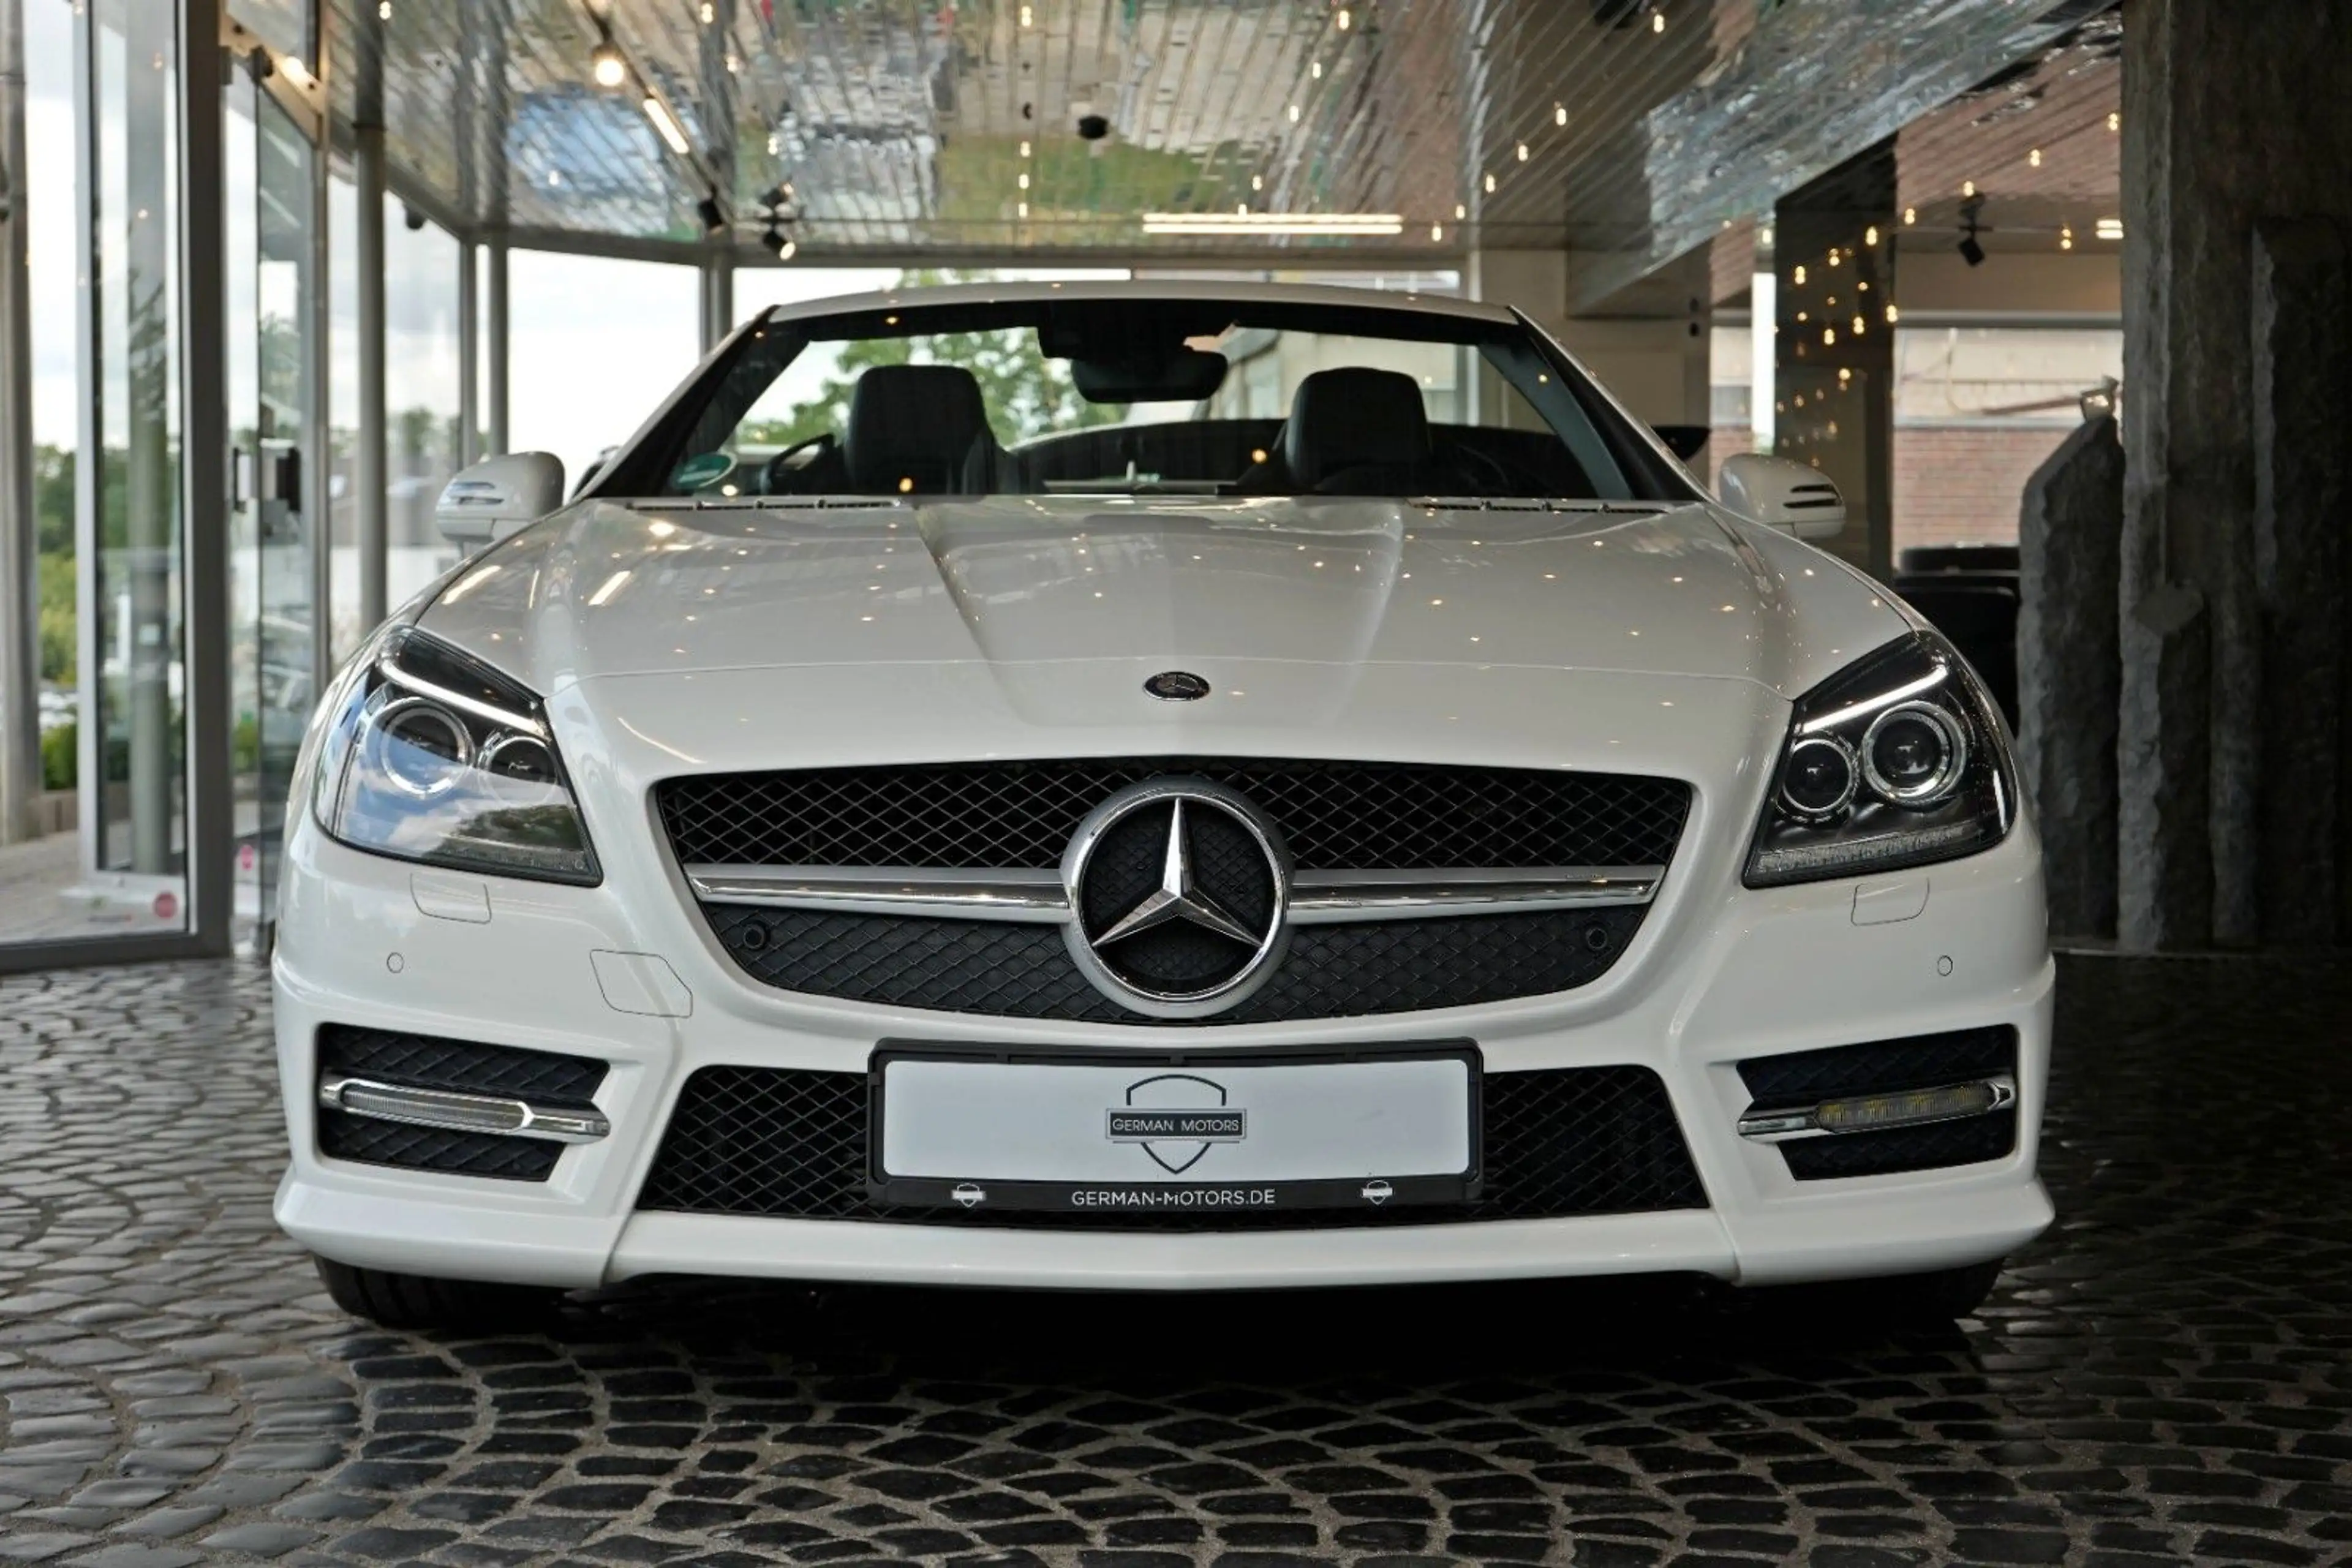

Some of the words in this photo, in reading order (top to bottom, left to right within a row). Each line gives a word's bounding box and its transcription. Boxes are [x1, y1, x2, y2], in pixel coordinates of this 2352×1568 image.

[1112, 1118, 1174, 1131] GERMAN
[1181, 1119, 1239, 1132] MOTORS
[1072, 1189, 1276, 1205] GERMAN-MOTORS.DE
